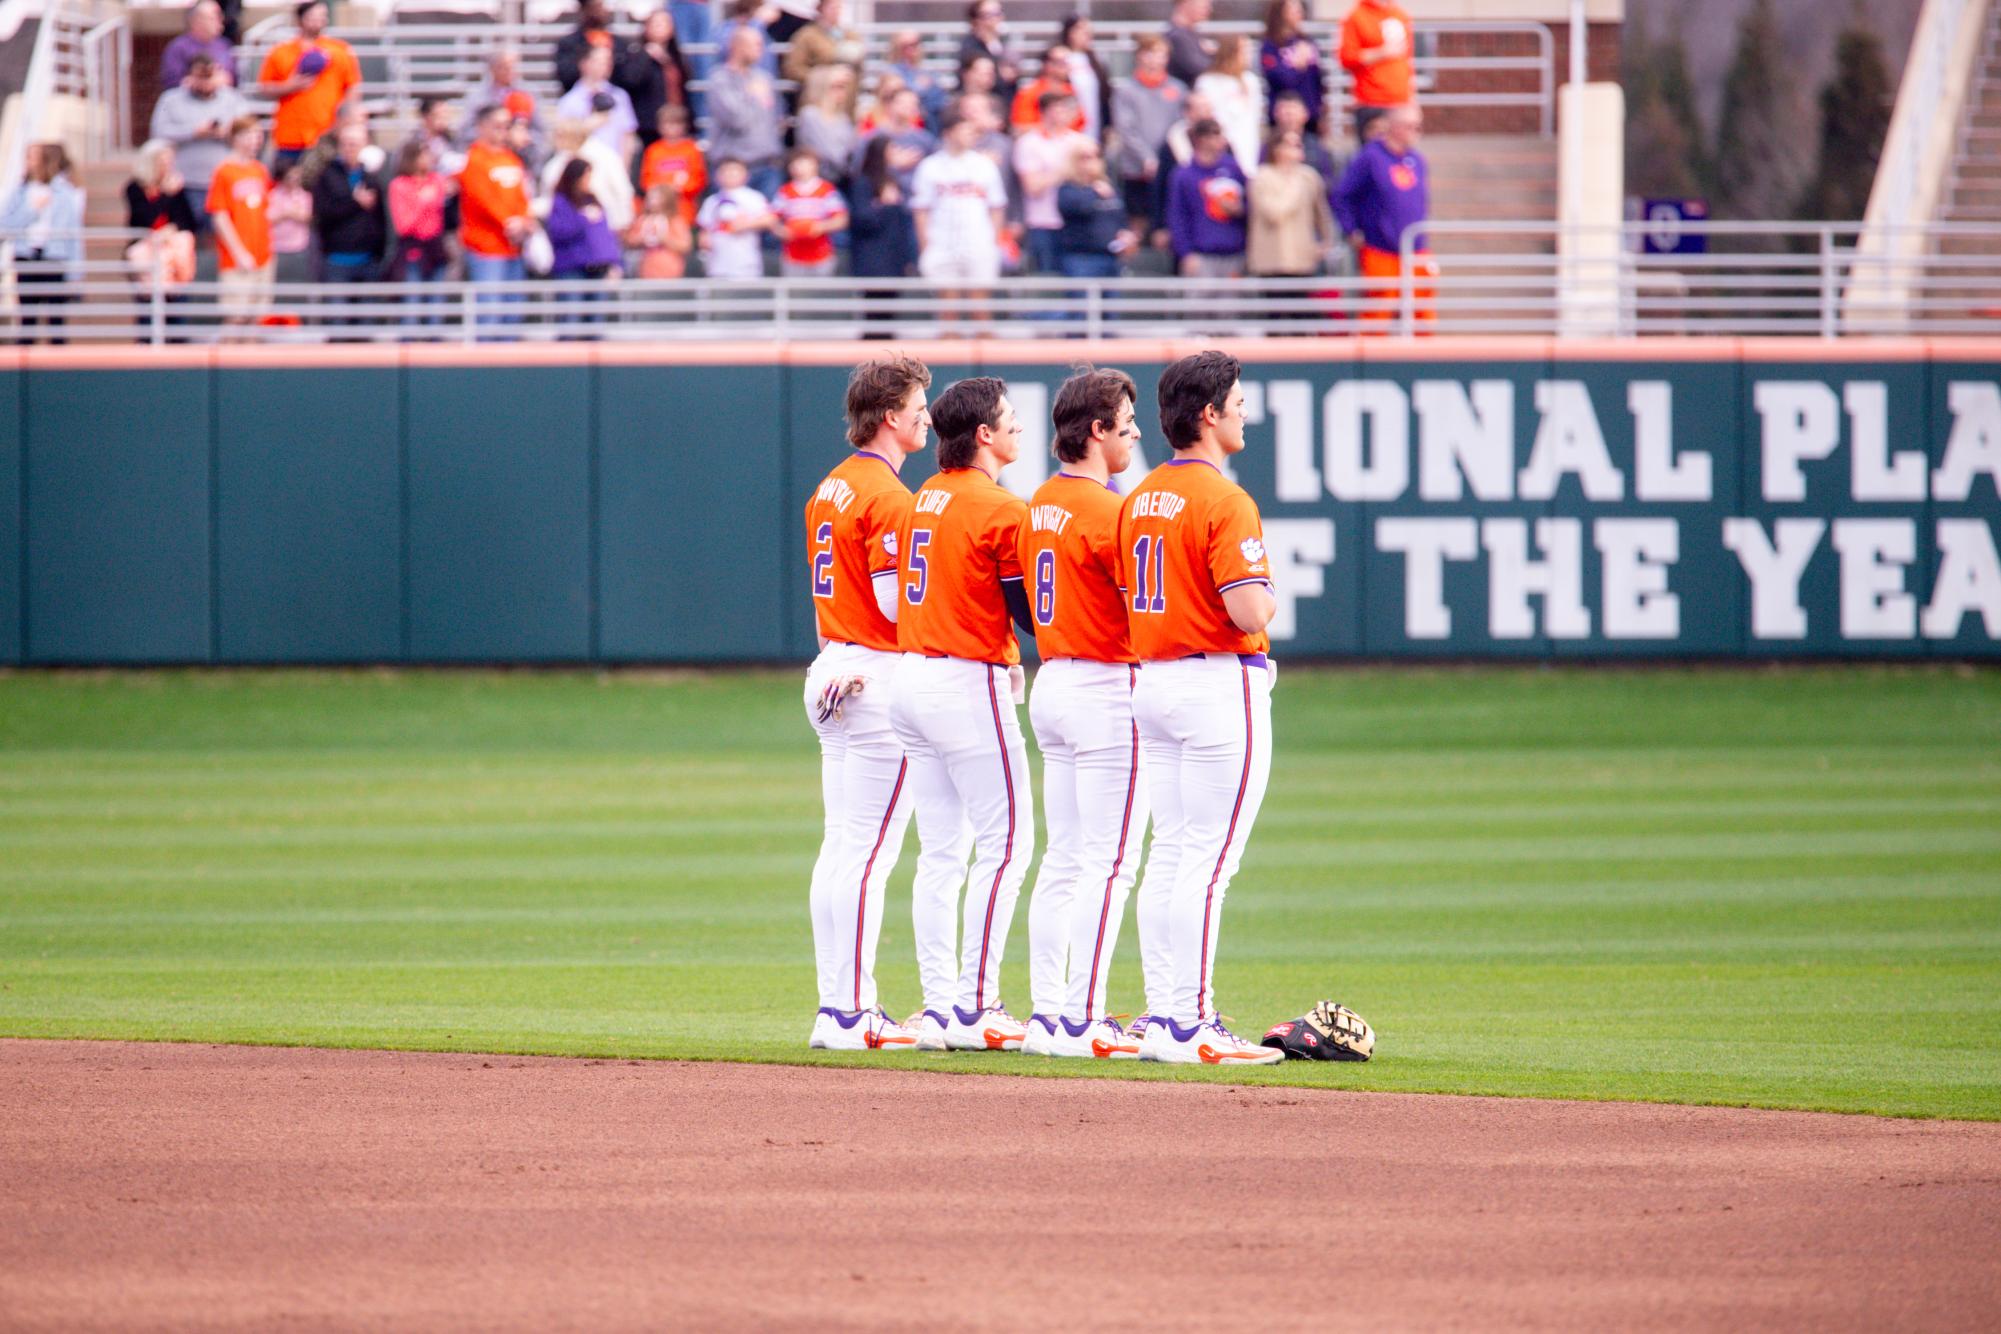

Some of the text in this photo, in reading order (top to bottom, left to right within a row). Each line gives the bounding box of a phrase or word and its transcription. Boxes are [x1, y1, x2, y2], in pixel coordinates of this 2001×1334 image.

[813, 521, 835, 599] 2
[905, 529, 932, 606] 5
[1036, 548, 1056, 626] 8
[1132, 534, 1166, 614] 11
[1376, 516, 1681, 640] THE
